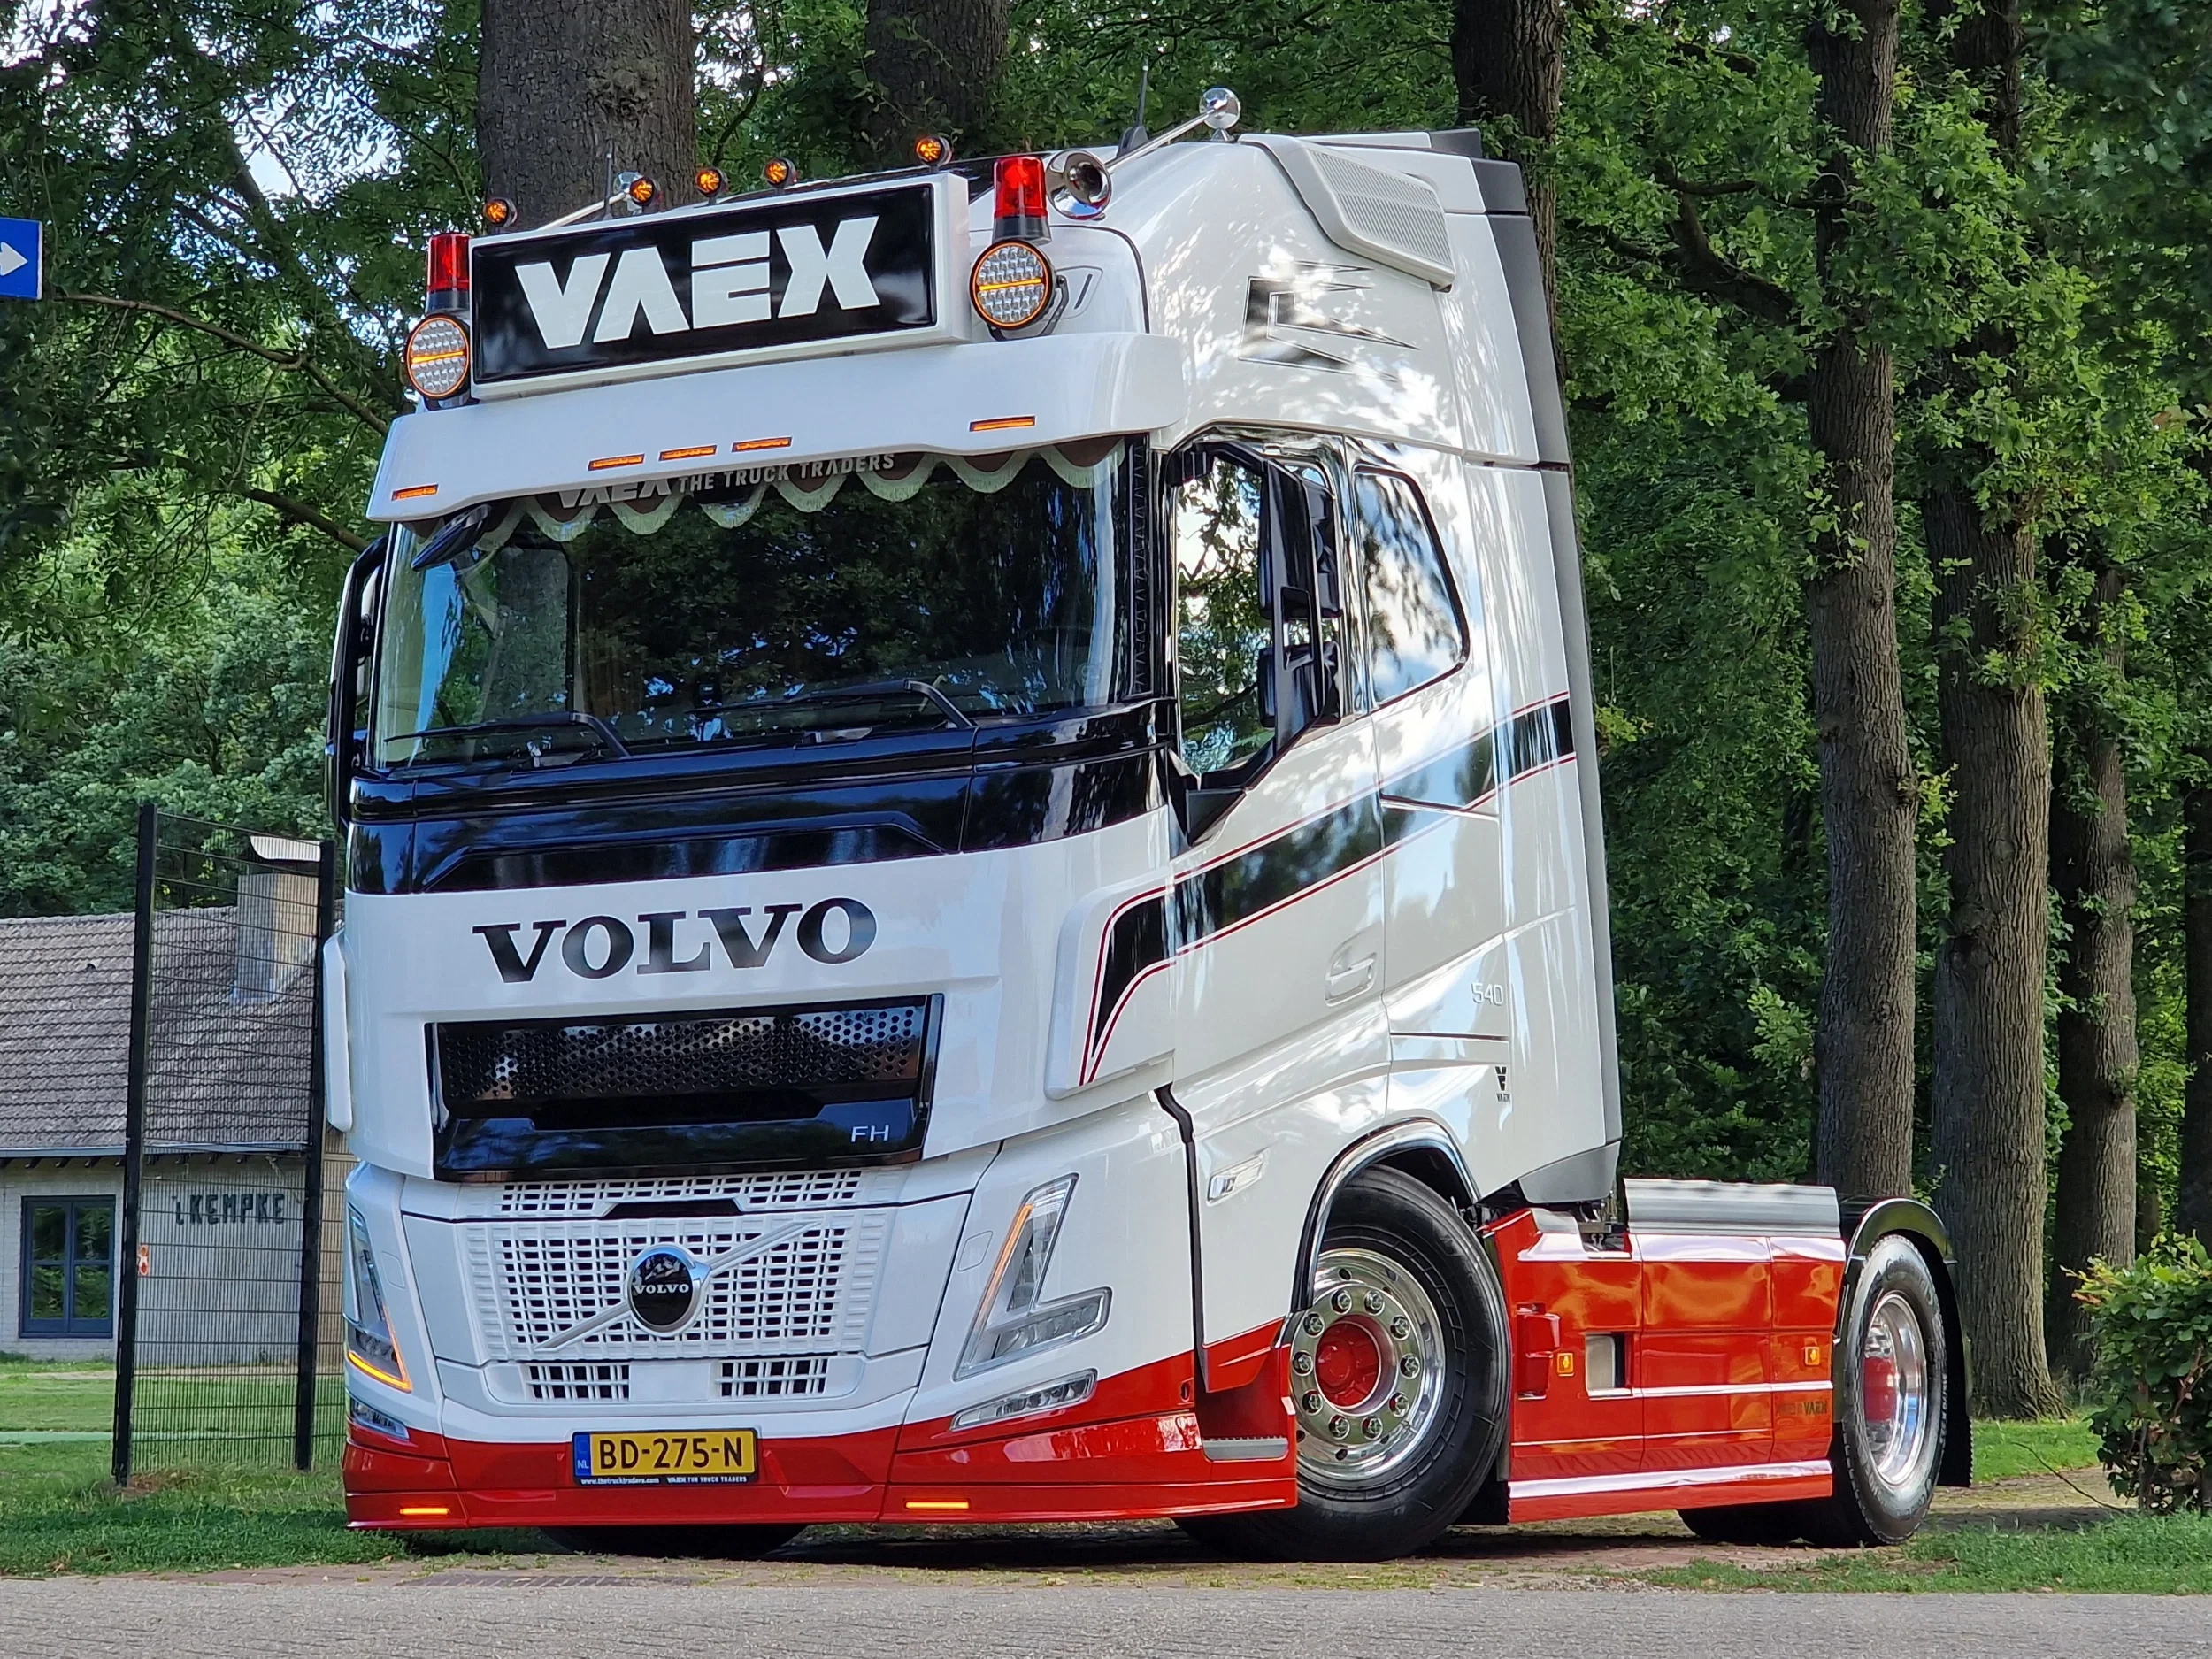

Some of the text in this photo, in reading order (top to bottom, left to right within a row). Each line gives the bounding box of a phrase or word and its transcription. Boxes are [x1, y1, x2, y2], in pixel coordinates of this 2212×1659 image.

[515, 215, 881, 349] VAEX
[679, 472, 715, 493] THE
[724, 465, 790, 488] TRUCK
[799, 454, 895, 479] TRADERS
[472, 896, 877, 984] VOLVO
[1471, 982, 1504, 1006] 540
[851, 1125, 889, 1142] FH
[190, 1194, 284, 1225] KEMPKE
[634, 1283, 689, 1294] VOLVO
[577, 1460, 589, 1469] NL
[599, 1437, 742, 1470] BD-275-N
